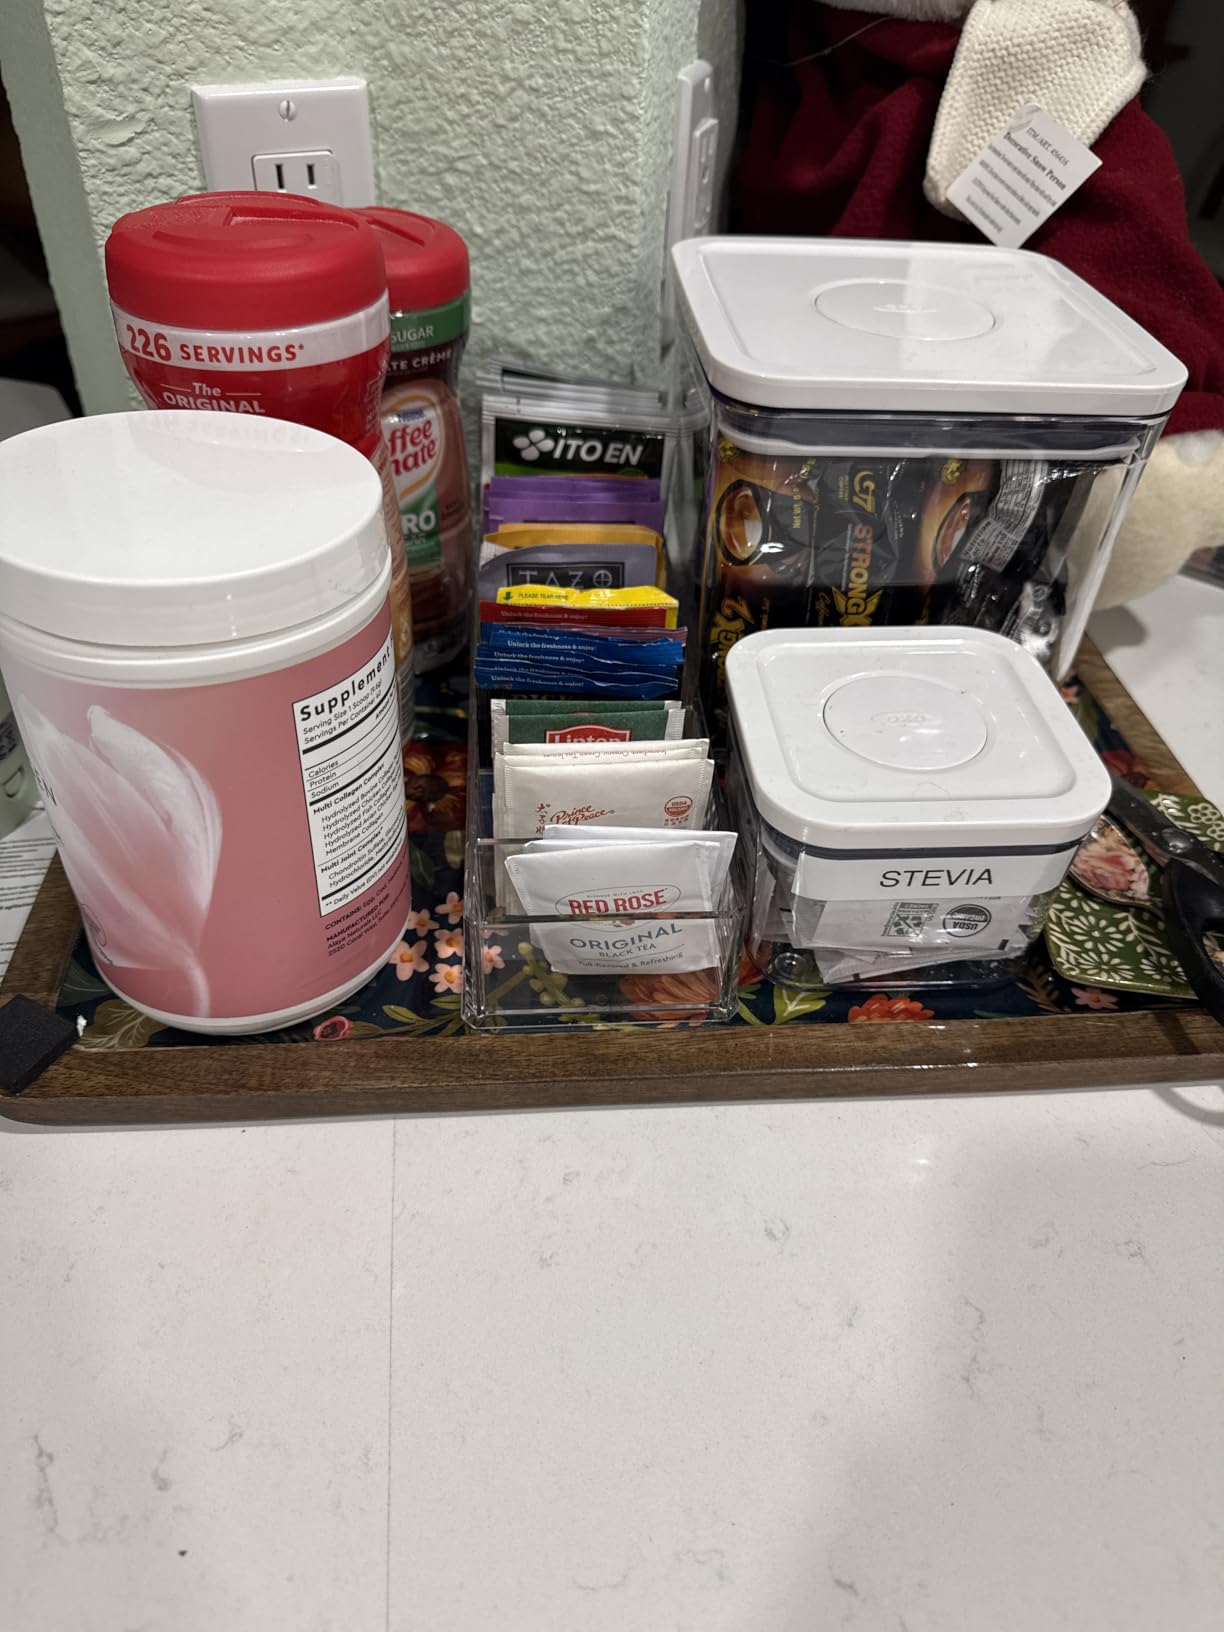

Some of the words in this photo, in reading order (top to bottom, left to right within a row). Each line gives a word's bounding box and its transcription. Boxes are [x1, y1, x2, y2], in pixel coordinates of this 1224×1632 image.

[1045, 169, 1067, 191] Person
[126, 324, 172, 362] 226
[192, 382, 221, 397] The
[162, 391, 265, 413] ORIGINAL
[388, 420, 432, 457] ffee
[553, 438, 602, 462] ITO
[603, 442, 643, 466] EN
[400, 510, 436, 534] RO
[518, 569, 613, 588] TAZO
[845, 522, 874, 615] STRONG
[507, 639, 530, 648] Unlock
[530, 641, 540, 649] the
[541, 641, 571, 650] freshness
[300, 648, 391, 722] Supplement
[303, 718, 332, 735] Serving
[333, 709, 348, 721] Size
[352, 692, 370, 710] Scoop
[304, 725, 337, 744] Servings
[338, 718, 349, 728] Per
[349, 697, 376, 721] Container
[308, 760, 339, 778] Calories
[309, 772, 337, 788] Protein
[311, 781, 340, 799] Sodium
[313, 801, 333, 815] Multi
[333, 784, 363, 805] Collagen
[321, 796, 360, 823] Hydrolyzed
[360, 782, 378, 800] Bovine
[323, 804, 361, 832] Hydrolyzed
[361, 788, 382, 808] Chicken
[550, 805, 592, 824] Prince
[323, 813, 362, 840] Hydrolyzed
[362, 804, 373, 816] Fish
[573, 809, 610, 825] Peace
[324, 821, 362, 848] Hydrolyzed
[325, 832, 361, 856] Membrane
[361, 812, 384, 834] Collagen
[321, 859, 339, 873] Multi
[341, 850, 357, 864] Joint
[328, 853, 367, 880] Chondroitin
[880, 868, 993, 888] STEVIA
[333, 893, 350, 905] Daily
[350, 882, 366, 894] Value
[568, 899, 609, 914] RED
[613, 889, 667, 912] ROSE
[326, 904, 379, 942] MANUFACTURED
[952, 921, 979, 930] USDA
[570, 923, 683, 950] ORIGINAL
[599, 948, 633, 958] BLACK
[636, 943, 657, 952] TEA
[640, 952, 684, 967] Refreshing
